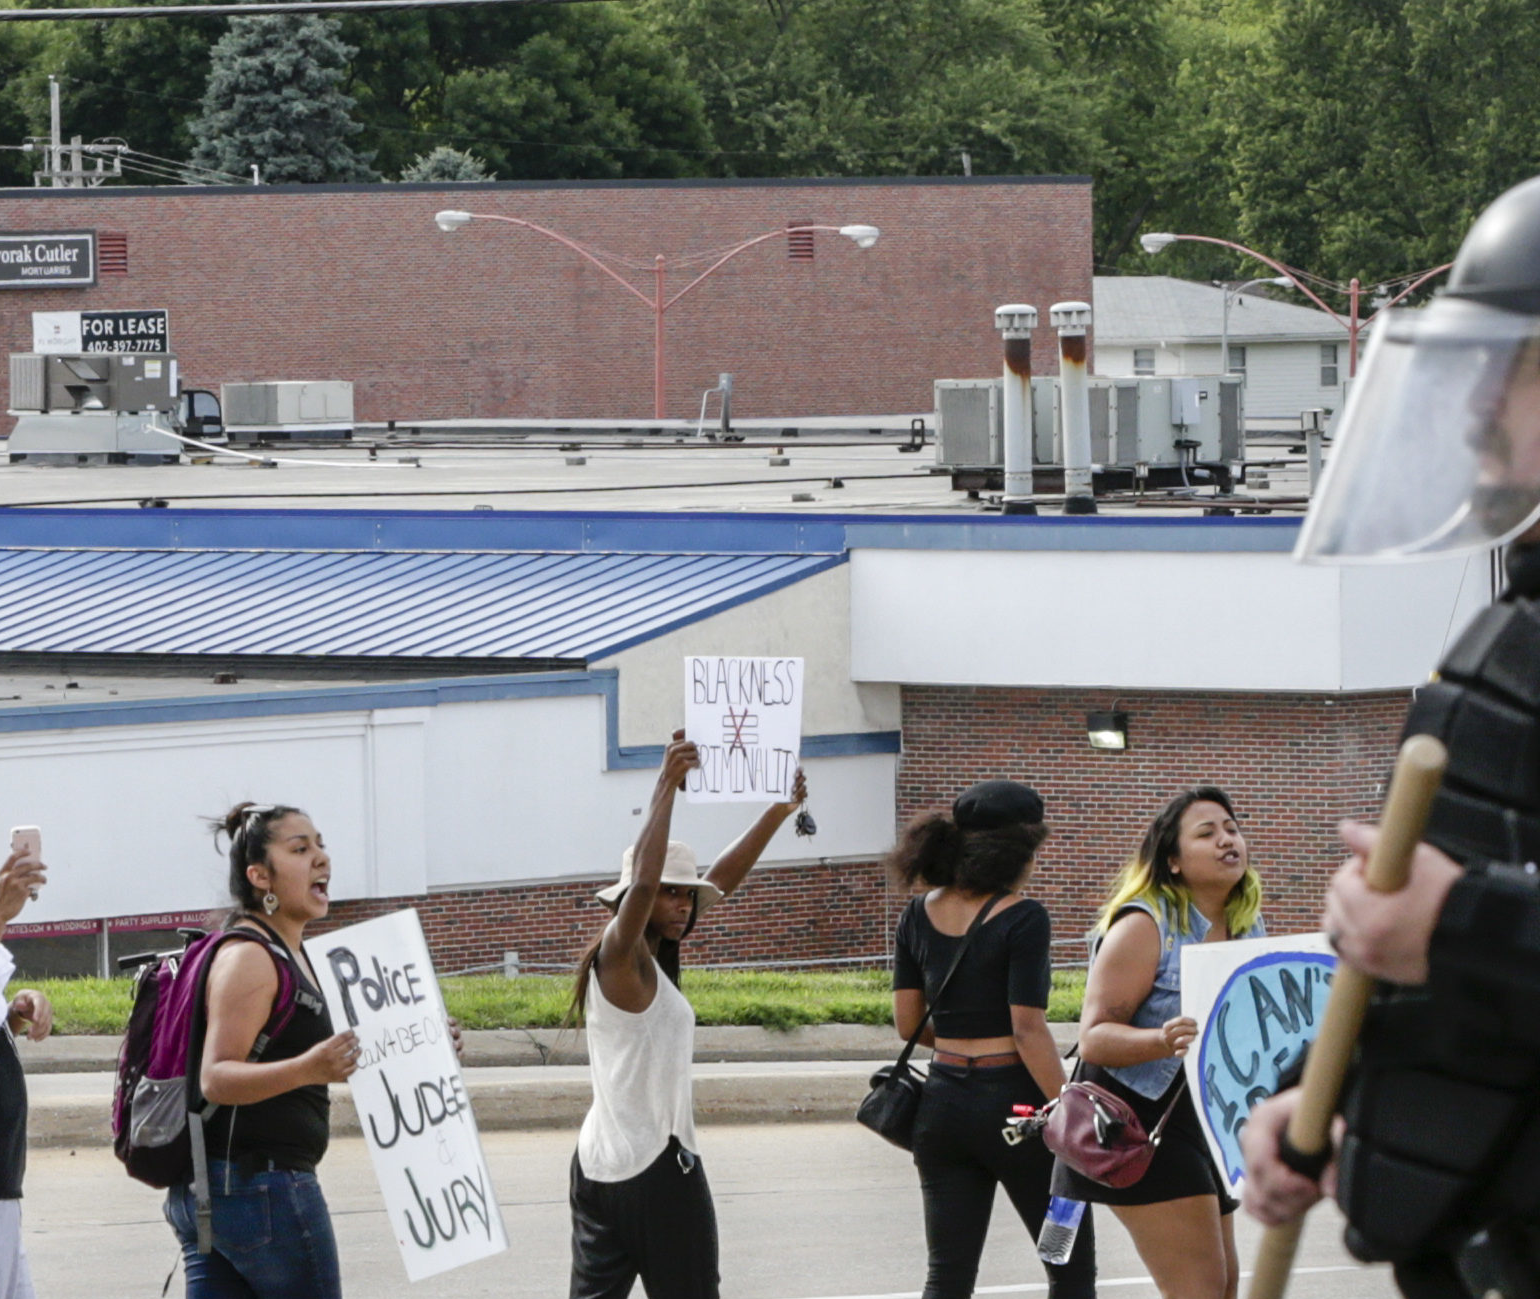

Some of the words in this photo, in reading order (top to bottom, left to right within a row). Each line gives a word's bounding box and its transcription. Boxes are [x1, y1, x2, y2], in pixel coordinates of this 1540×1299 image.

[34, 244, 79, 263] Cutler
[20, 265, 72, 276] MORTUARIES
[82, 319, 114, 336] FOR
[119, 318, 165, 335] LEASE
[87, 340, 161, 352] 402-397-7775
[693, 658, 795, 706] BLACKNESS
[52, 920, 92, 931] WEDDINGS
[115, 917, 139, 927] PARTY
[140, 916, 173, 926] SUPPLIES
[1217, 967, 1332, 1087] CAN'
[1205, 1064, 1238, 1134] I
